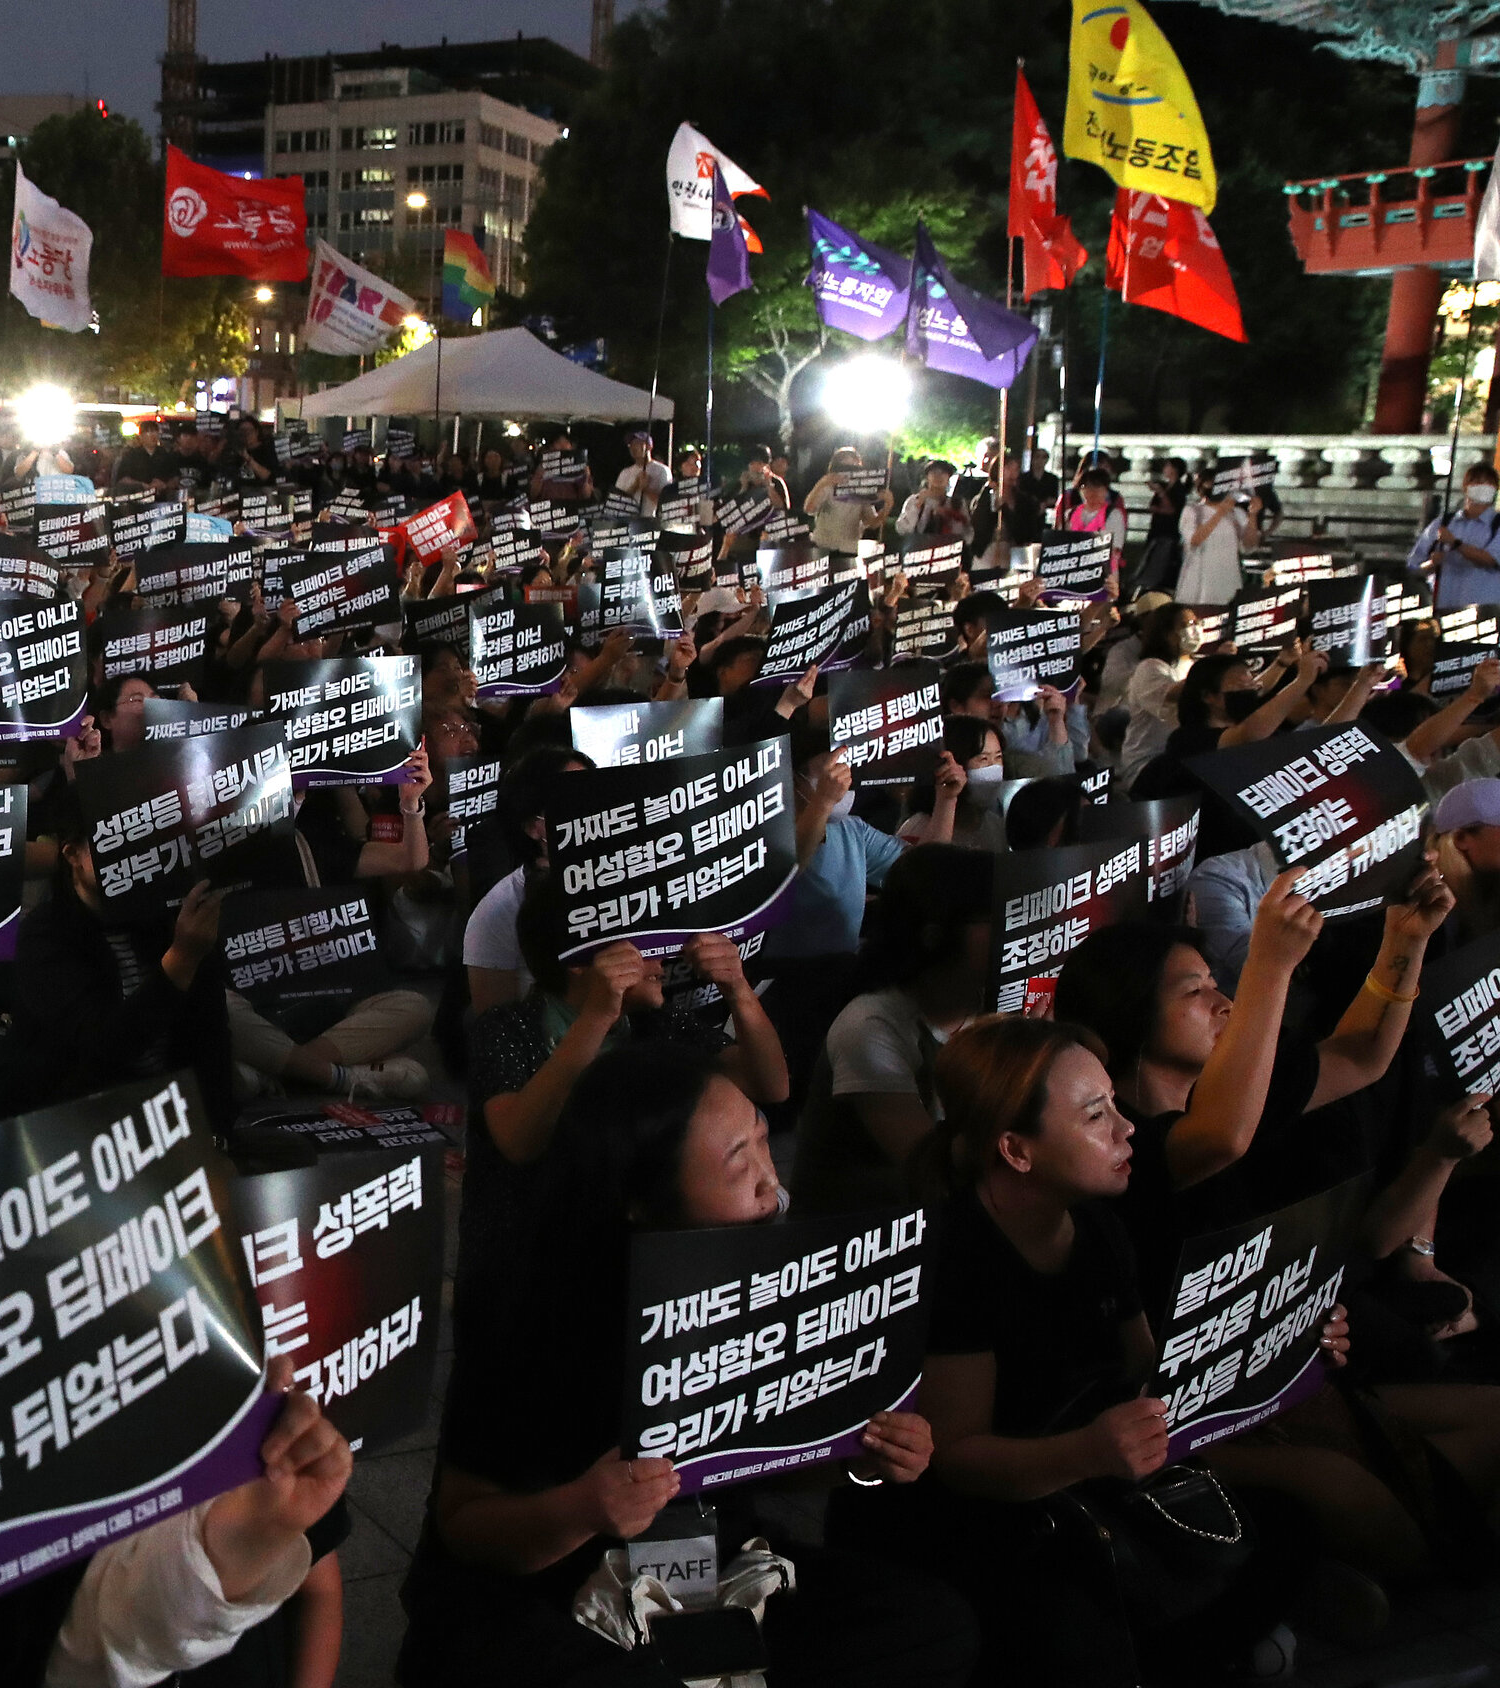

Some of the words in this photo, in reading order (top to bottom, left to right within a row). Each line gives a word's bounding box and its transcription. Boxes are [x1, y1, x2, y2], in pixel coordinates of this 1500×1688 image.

[291, 565, 344, 598] 딥페이크
[346, 548, 386, 575] 성폭력
[295, 586, 347, 614] 조장하는
[37, 601, 78, 630] 아니다
[297, 607, 336, 635] 플랫폼
[338, 585, 390, 617] 규제하라
[472, 609, 516, 637] 불안과
[473, 635, 513, 660] 두려움
[516, 625, 542, 647] 아닌
[17, 631, 81, 670] 딥페이크
[474, 658, 513, 684] 일상을
[516, 640, 565, 673] 쟁취하자
[1, 667, 71, 708] 뒤엎는다
[270, 687, 323, 713] 가짜도
[324, 678, 372, 702] 놀이도
[350, 686, 416, 723] 딥페이크
[832, 704, 884, 742] 성평등
[886, 683, 941, 722] 퇴행시킨
[332, 721, 402, 758] 뒤엎는다
[886, 715, 944, 756] 공범이다
[92, 789, 183, 854] 성평등
[184, 742, 285, 816] 퇴행시킨
[555, 803, 639, 852] 가짜도
[642, 773, 719, 820] 놀이도
[721, 742, 784, 790] 아니다
[1236, 758, 1324, 819] 딥페이크
[1312, 725, 1381, 777] 성폭력
[99, 835, 192, 897] 정부가
[195, 792, 291, 859] 공범이다
[562, 833, 686, 896] 여성혐오
[690, 782, 786, 855] 딥페이크
[1271, 795, 1358, 864] 조장하는
[1350, 804, 1422, 884] 규제하라
[566, 887, 663, 940] 우리가
[666, 838, 767, 909] 뒤엎는다
[1004, 870, 1092, 932] 딥페이크
[1095, 841, 1141, 892] 성폭력
[224, 928, 286, 960] 성평등
[288, 898, 370, 942] 퇴행시킨
[230, 959, 294, 989] 정부가
[294, 930, 377, 974] 공범이다
[999, 916, 1091, 975] 조장하는
[90, 1081, 191, 1195] 아니다
[312, 1156, 423, 1260] 성폭력
[47, 1167, 222, 1332] 딥페이크
[640, 1277, 741, 1346] 가짜도
[747, 1246, 838, 1310] 놀이도
[843, 1208, 927, 1275] 아니다
[1173, 1225, 1273, 1319] 불안과
[640, 1321, 786, 1407] 여성혐오
[794, 1264, 921, 1355] 딥페이크
[1159, 1290, 1257, 1378] 두려움
[1259, 1245, 1318, 1319] 아닌
[1246, 1265, 1345, 1378] 쟁취하자
[11, 1286, 212, 1470] 뒤엎는다
[638, 1388, 748, 1459] 우리가
[752, 1337, 887, 1427] 뒤엎는다
[637, 1557, 712, 1583] STAFF
